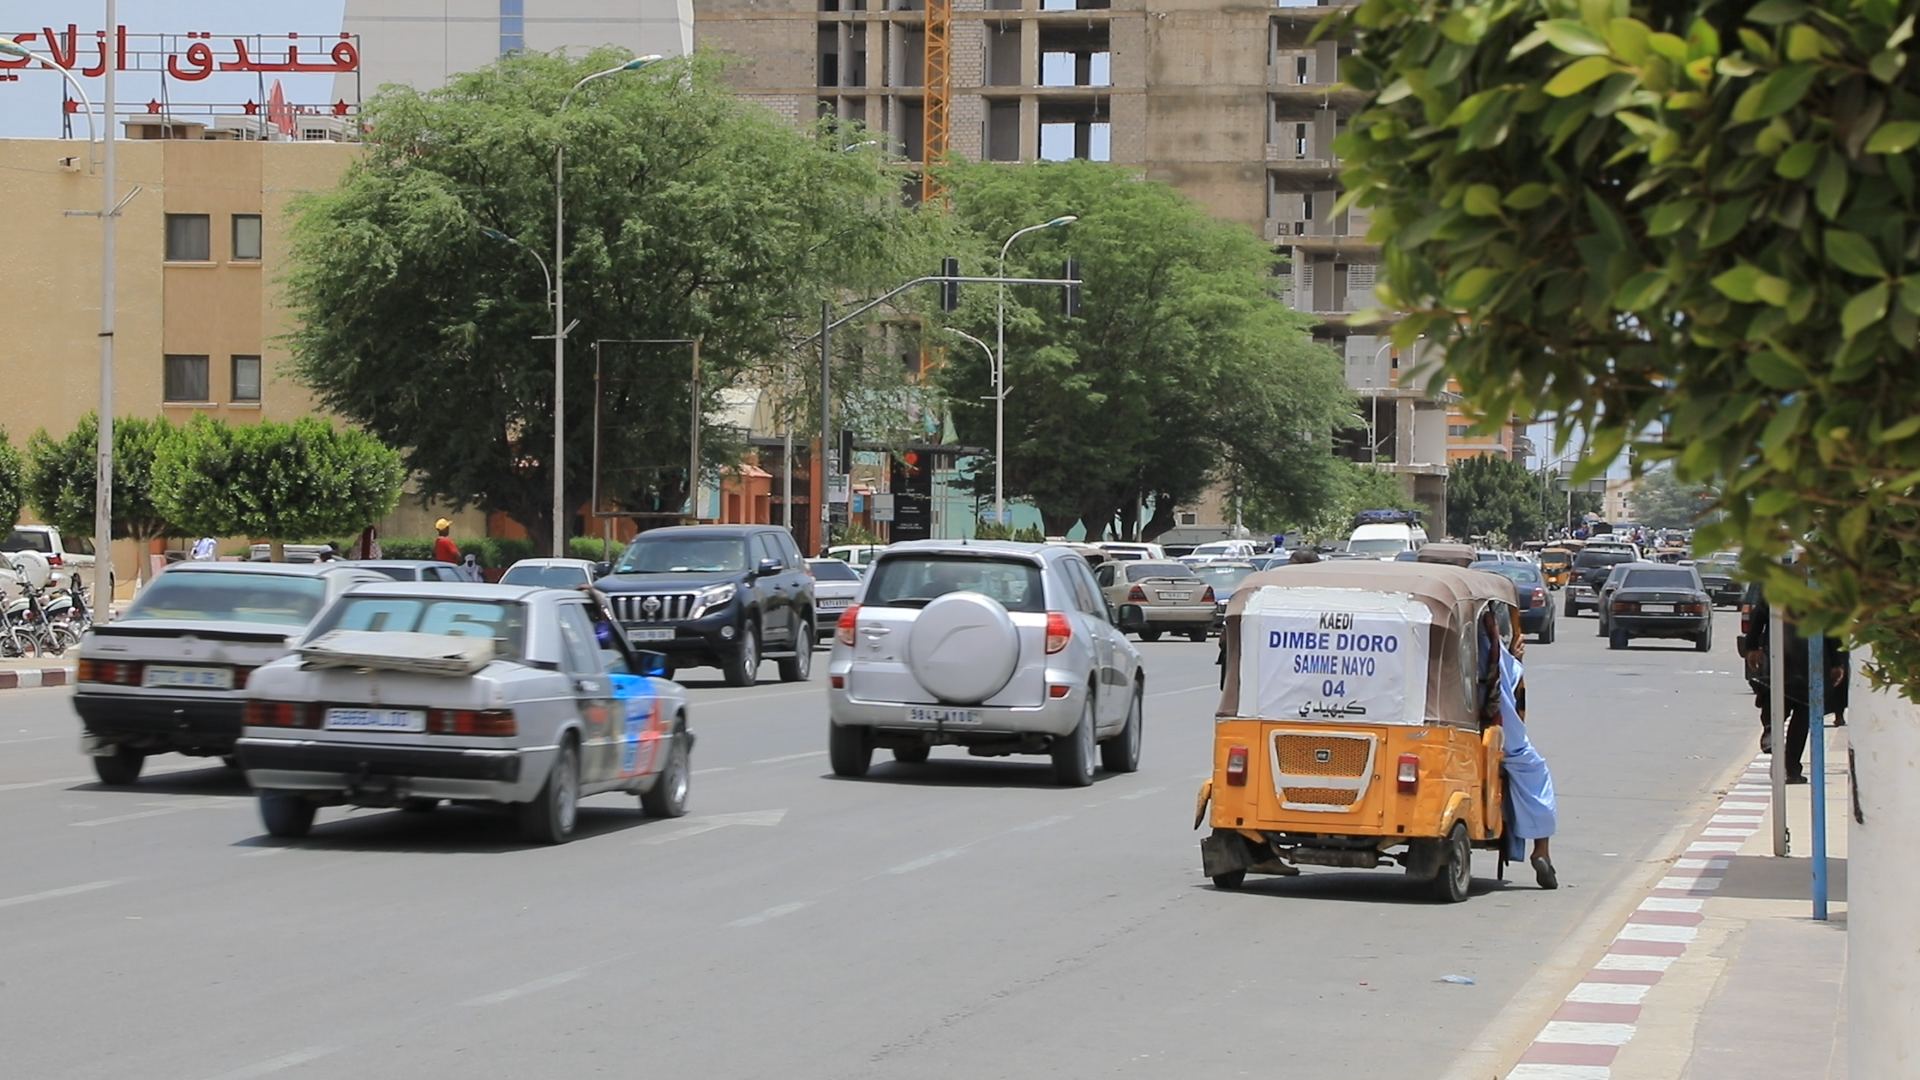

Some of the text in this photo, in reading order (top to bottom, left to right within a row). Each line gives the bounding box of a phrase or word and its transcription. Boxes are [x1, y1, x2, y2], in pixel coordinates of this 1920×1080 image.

[168, 32, 358, 81] فندق
[1319, 612, 1354, 630] KAEDI
[1269, 631, 1398, 653] DIMBE DIORO
[1293, 654, 1375, 677] SAMME NAYO
[1322, 679, 1345, 698] 04
[1299, 700, 1366, 718] كيهيدي
